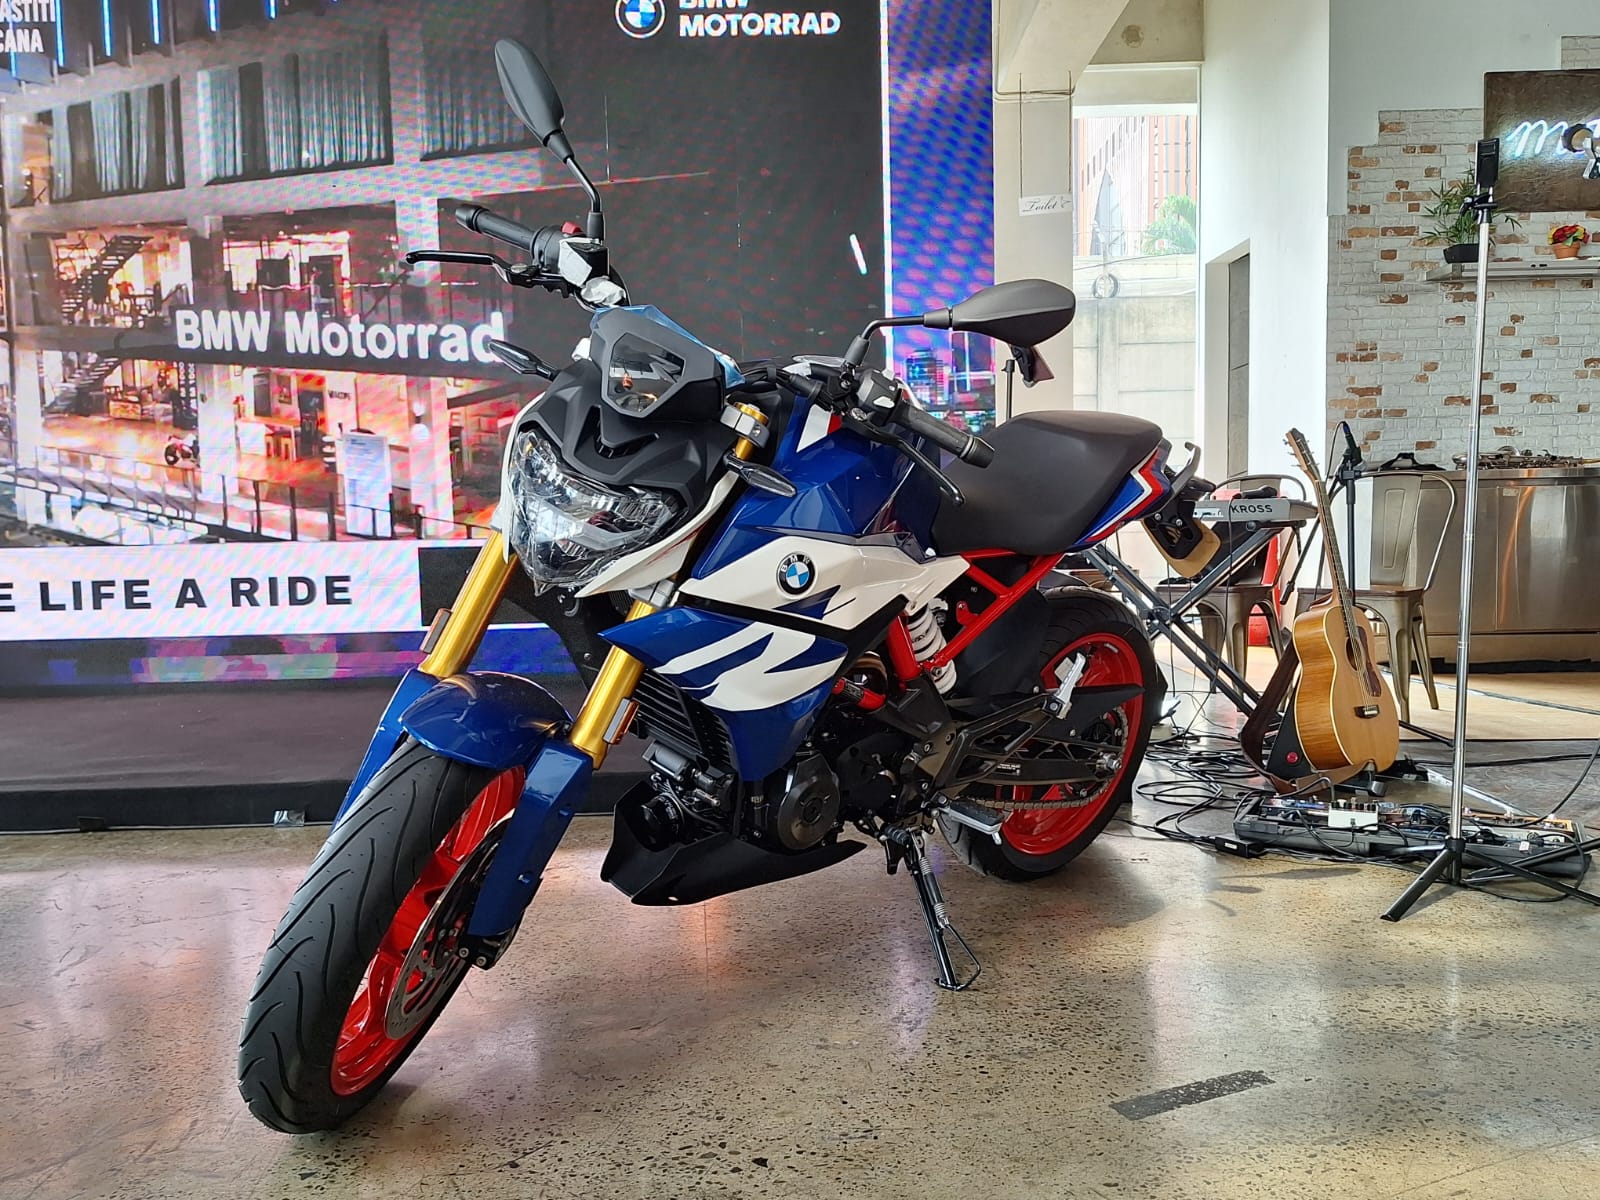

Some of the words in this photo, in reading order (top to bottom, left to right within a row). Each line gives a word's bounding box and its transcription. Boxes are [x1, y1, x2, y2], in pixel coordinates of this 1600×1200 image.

[679, 12, 841, 37] MOTORRAD
[1022, 195, 1058, 212] Toilet
[175, 308, 271, 352] BMW
[284, 310, 506, 364] Motorrad
[1231, 504, 1273, 514] KROSS
[780, 554, 811, 573] BMW
[39, 578, 152, 611] LIFE
[175, 578, 207, 609] A
[230, 575, 353, 608] RIDE
